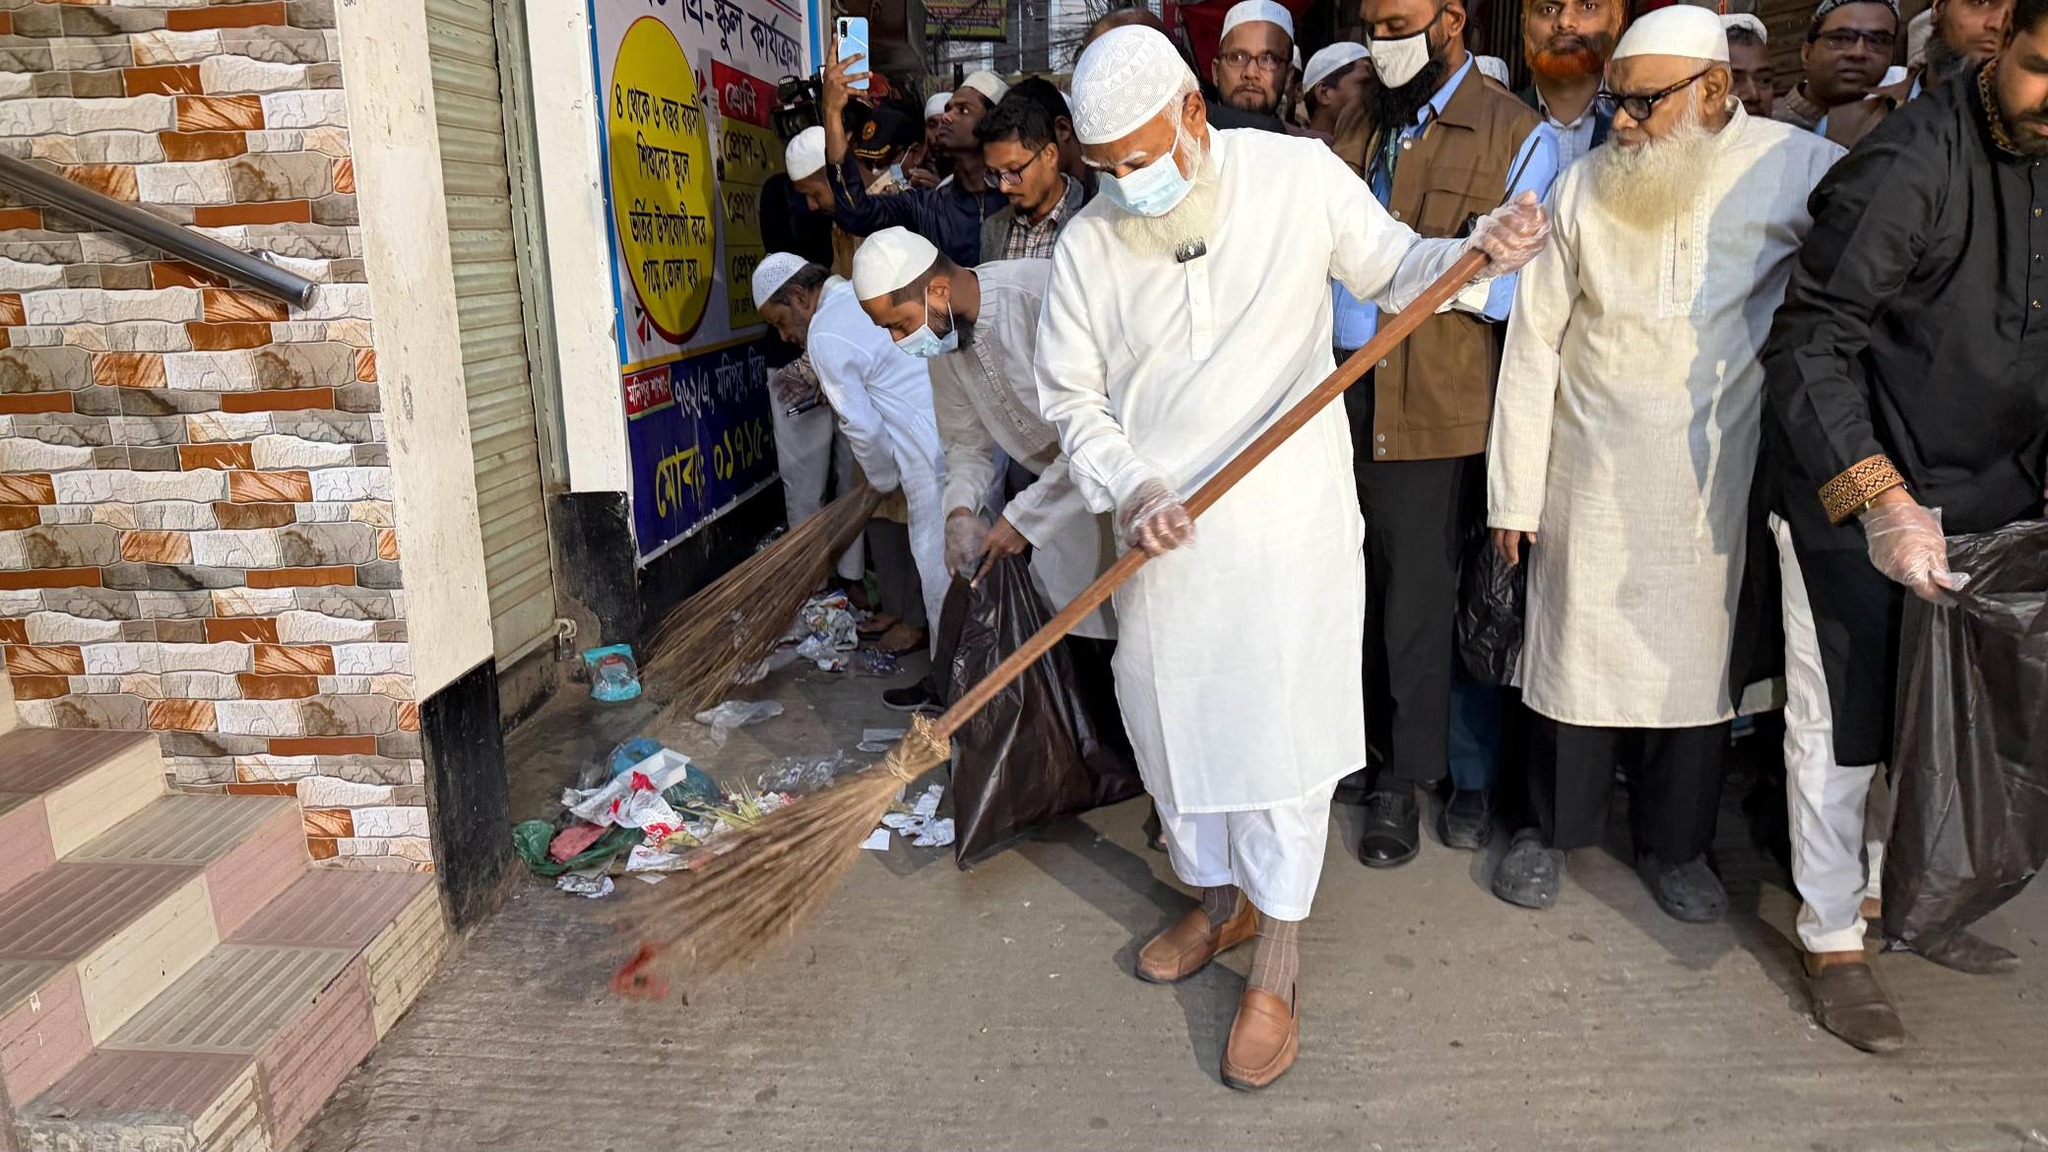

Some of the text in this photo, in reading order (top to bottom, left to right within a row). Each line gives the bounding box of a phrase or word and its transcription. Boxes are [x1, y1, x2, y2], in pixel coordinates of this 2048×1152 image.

[615, 82, 623, 118] ৪
[627, 84, 650, 126] থেকে
[652, 95, 660, 130] ৬
[661, 97, 679, 136] বছর
[636, 130, 670, 181] শিশুদের
[671, 150, 691, 193] স্কুলে
[629, 198, 706, 247] ভর্তির উপযোগী করে
[643, 258, 661, 299] গড়ে
[662, 257, 685, 292] তোলা
[714, 410, 773, 480] ০১৭১৫-
